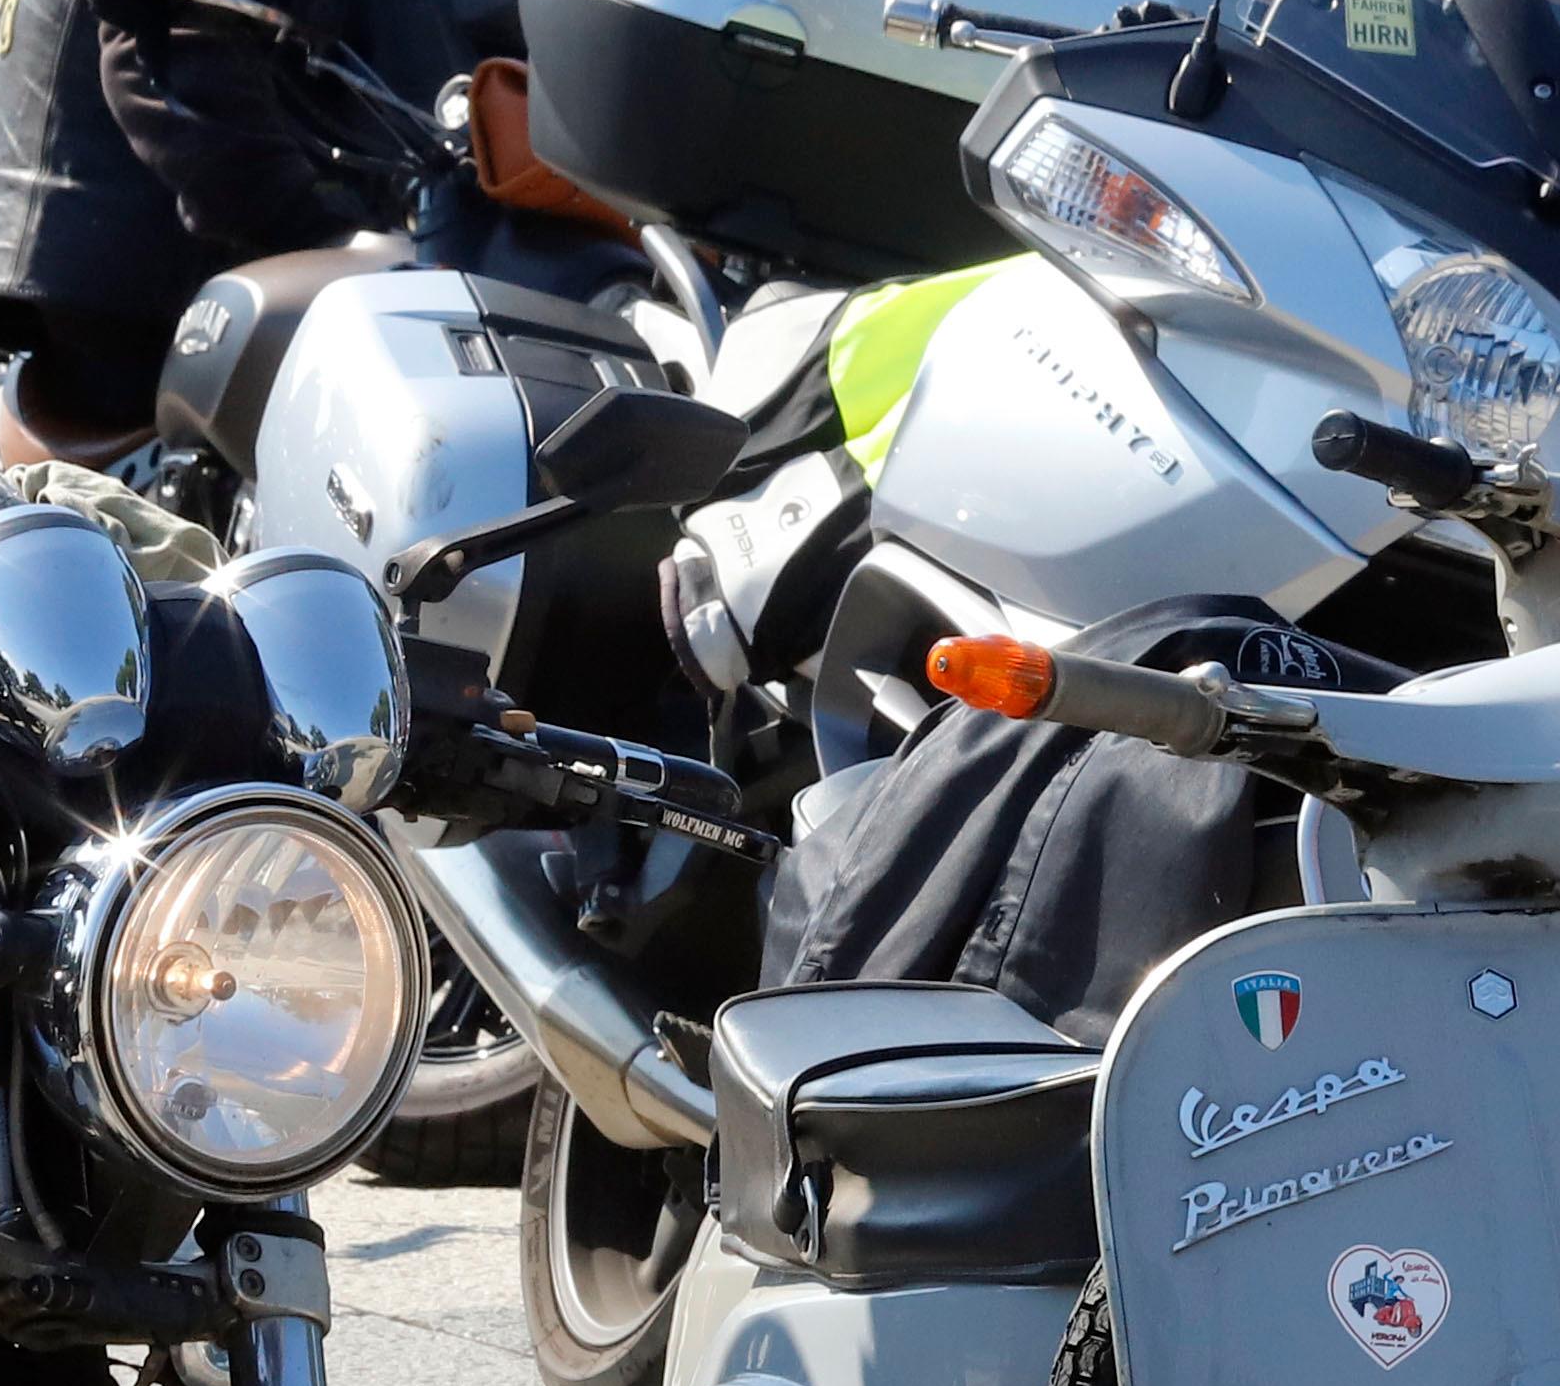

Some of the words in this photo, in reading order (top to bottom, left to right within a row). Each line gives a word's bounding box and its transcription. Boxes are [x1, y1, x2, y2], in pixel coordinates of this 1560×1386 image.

[1353, 23, 1409, 47] HIRN
[661, 809, 723, 841] WOLFMEN
[723, 829, 745, 848] MC
[1243, 976, 1291, 990] ITALIA
[1179, 1057, 1406, 1159] Vespa
[1173, 1133, 1454, 1253] Primavera
